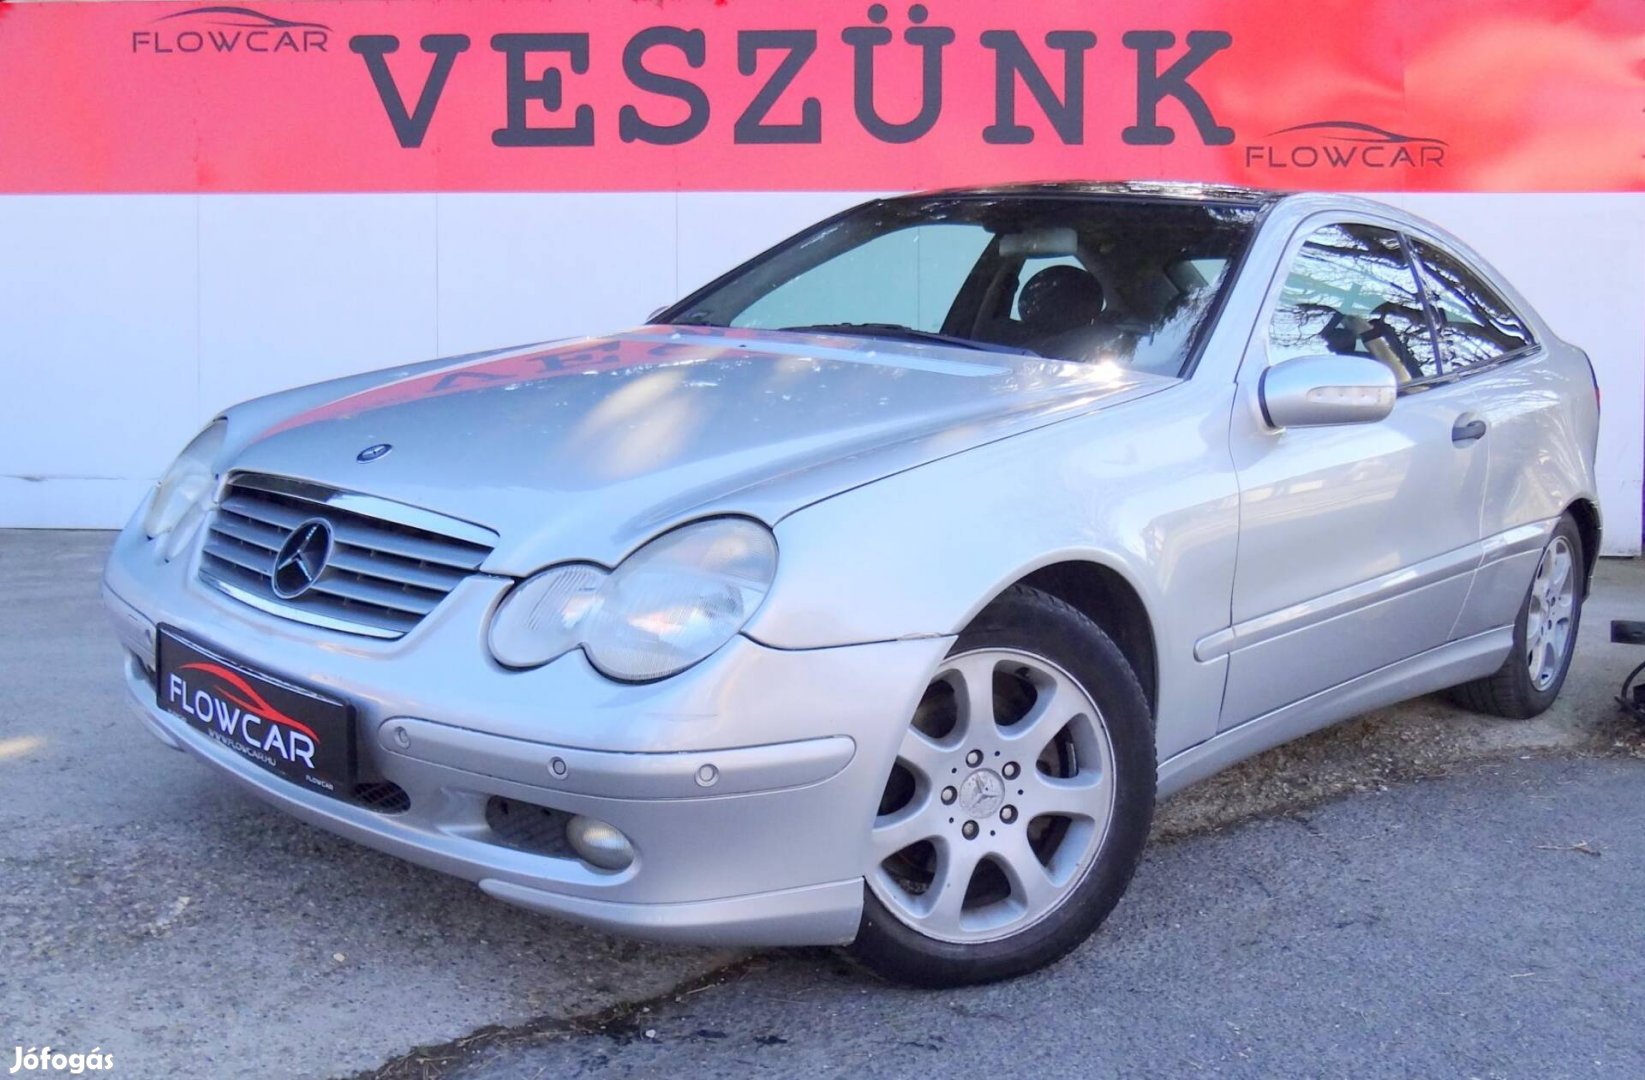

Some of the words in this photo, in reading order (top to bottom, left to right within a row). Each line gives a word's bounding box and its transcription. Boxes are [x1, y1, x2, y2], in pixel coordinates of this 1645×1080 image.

[132, 30, 328, 53] FLOWCAR
[348, 3, 1237, 149] VESZÜNK
[1245, 145, 1445, 168] FLOWCAR
[168, 671, 316, 769] FLOWCAR
